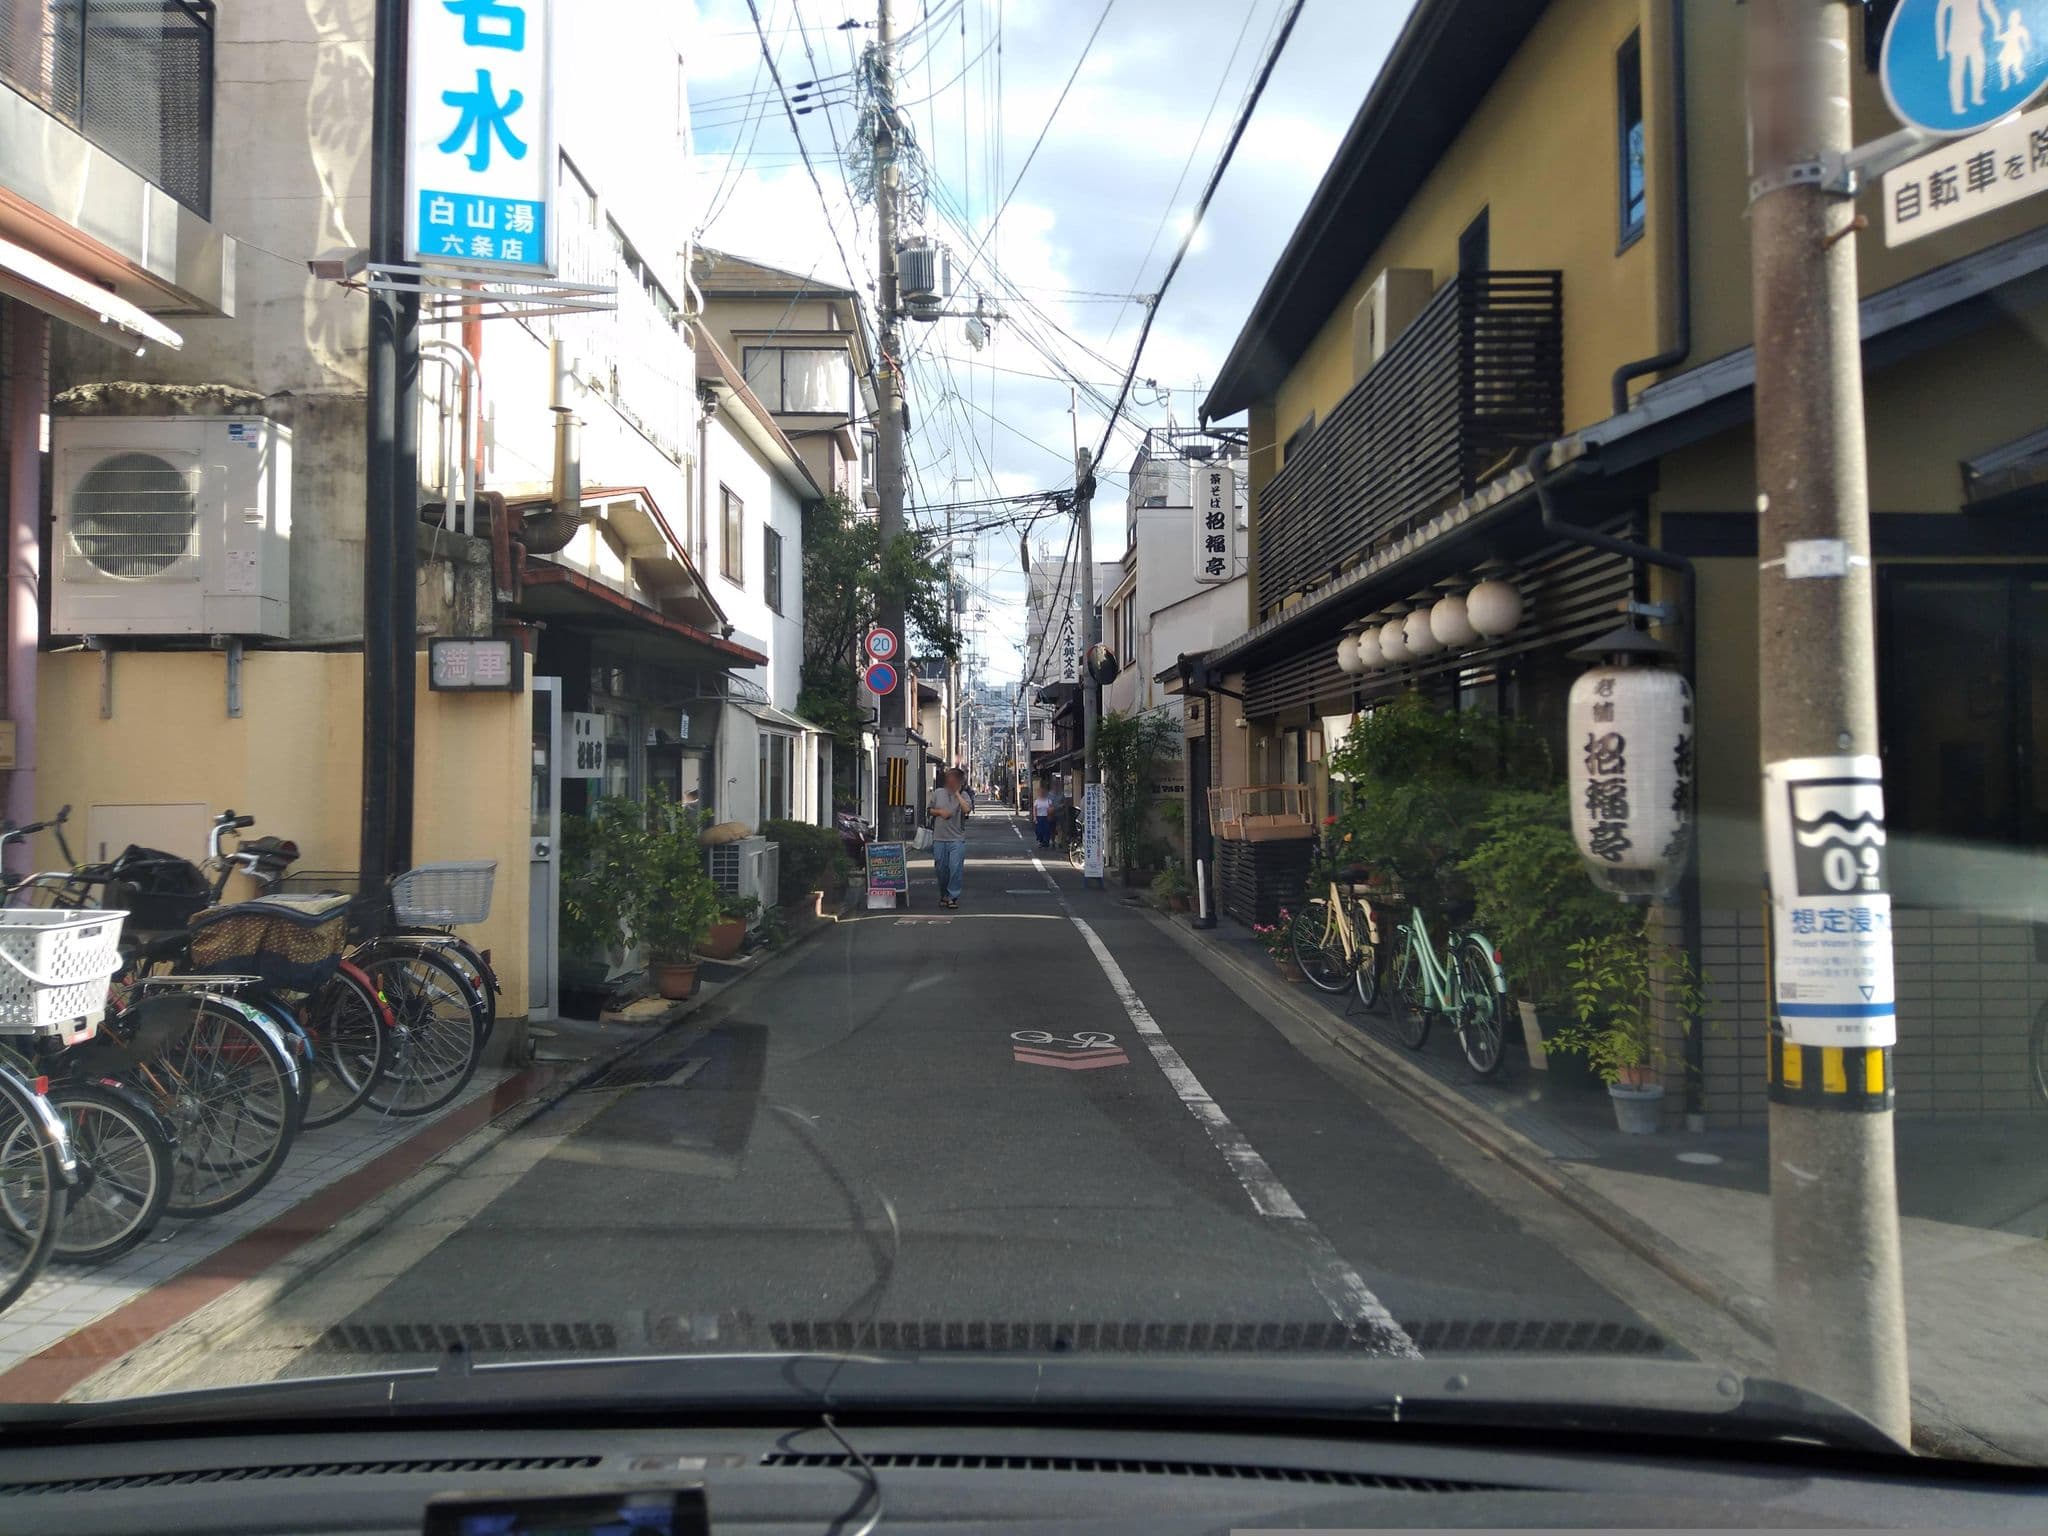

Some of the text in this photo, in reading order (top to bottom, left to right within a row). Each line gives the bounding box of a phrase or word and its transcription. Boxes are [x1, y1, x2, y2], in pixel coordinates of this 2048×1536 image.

[429, 196, 534, 234] 白山湯
[440, 234, 523, 261] 六条店
[873, 637, 890, 651] 20
[439, 649, 506, 679] 満車
[1584, 732, 1632, 864] 招福亭
